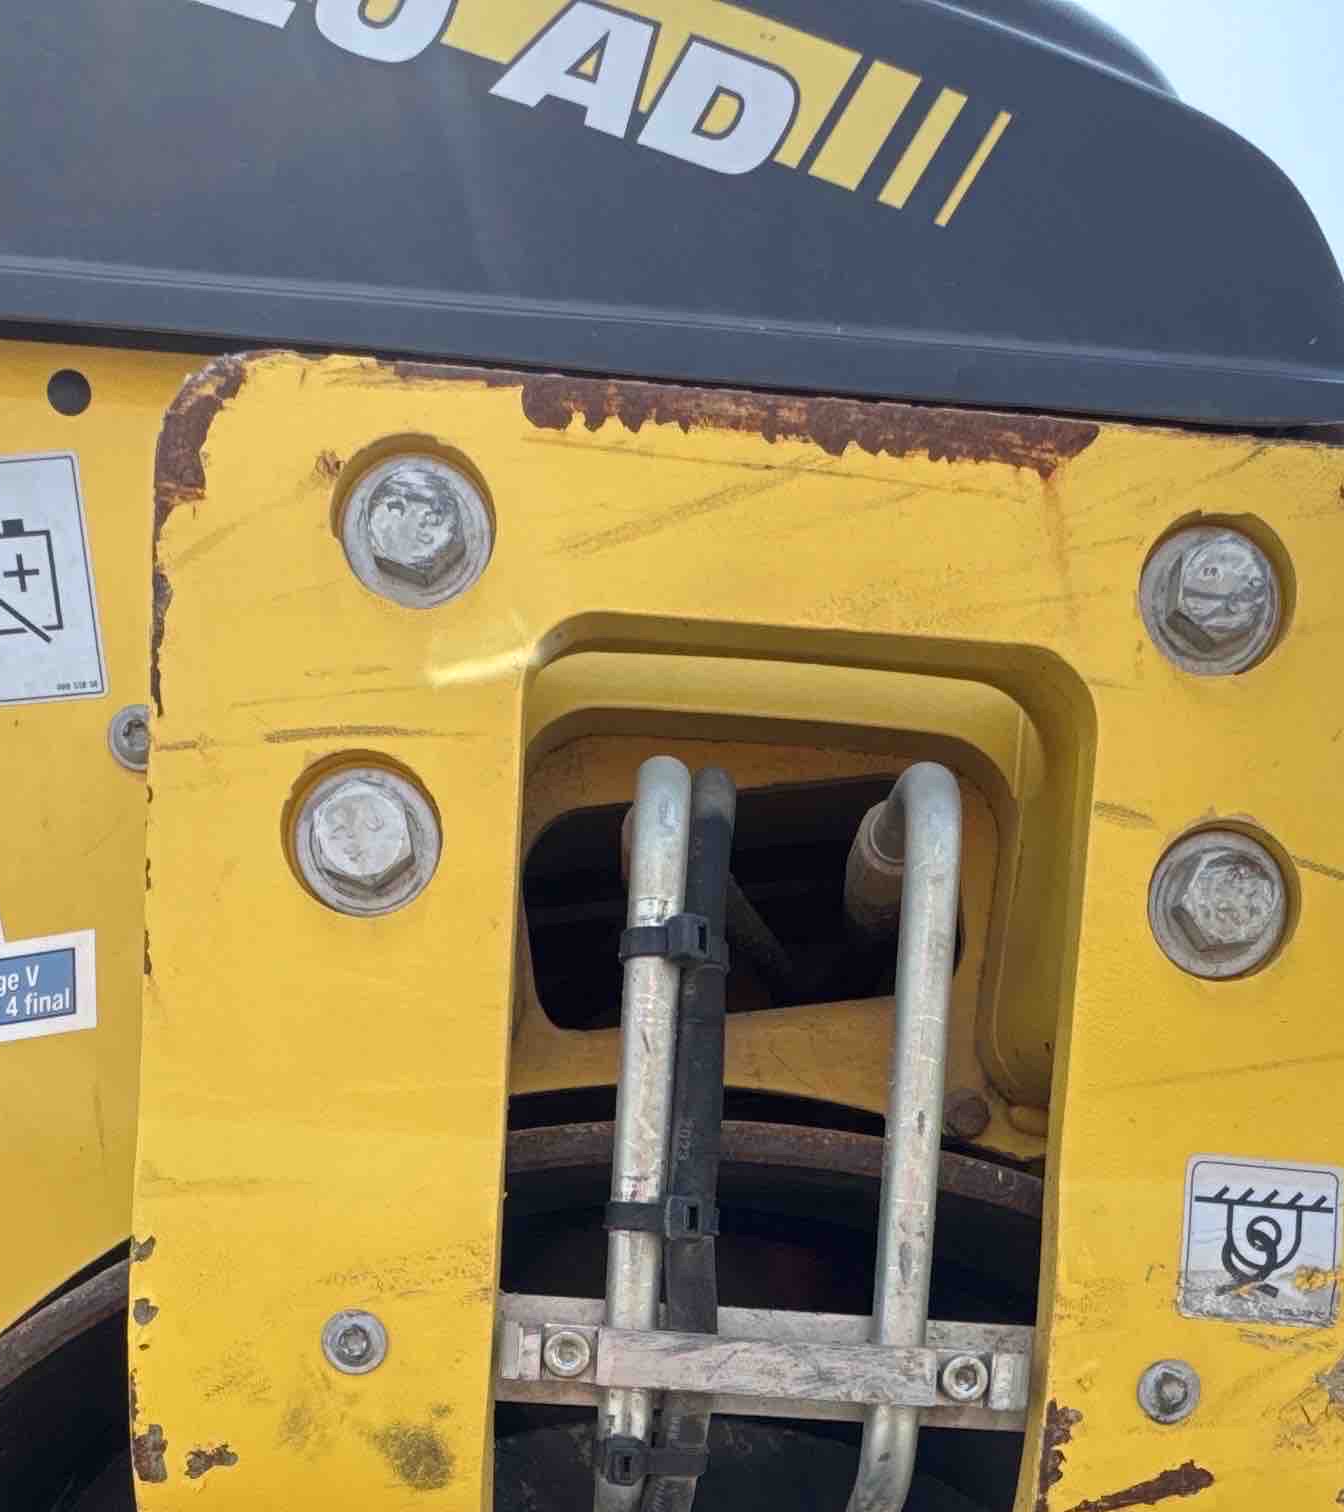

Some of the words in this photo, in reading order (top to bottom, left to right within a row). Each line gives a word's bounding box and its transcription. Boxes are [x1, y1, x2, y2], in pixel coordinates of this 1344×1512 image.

[488, 0, 796, 175] AD
[25, 965, 40, 987] V
[6, 997, 18, 1017] 4
[24, 987, 71, 1015] final
